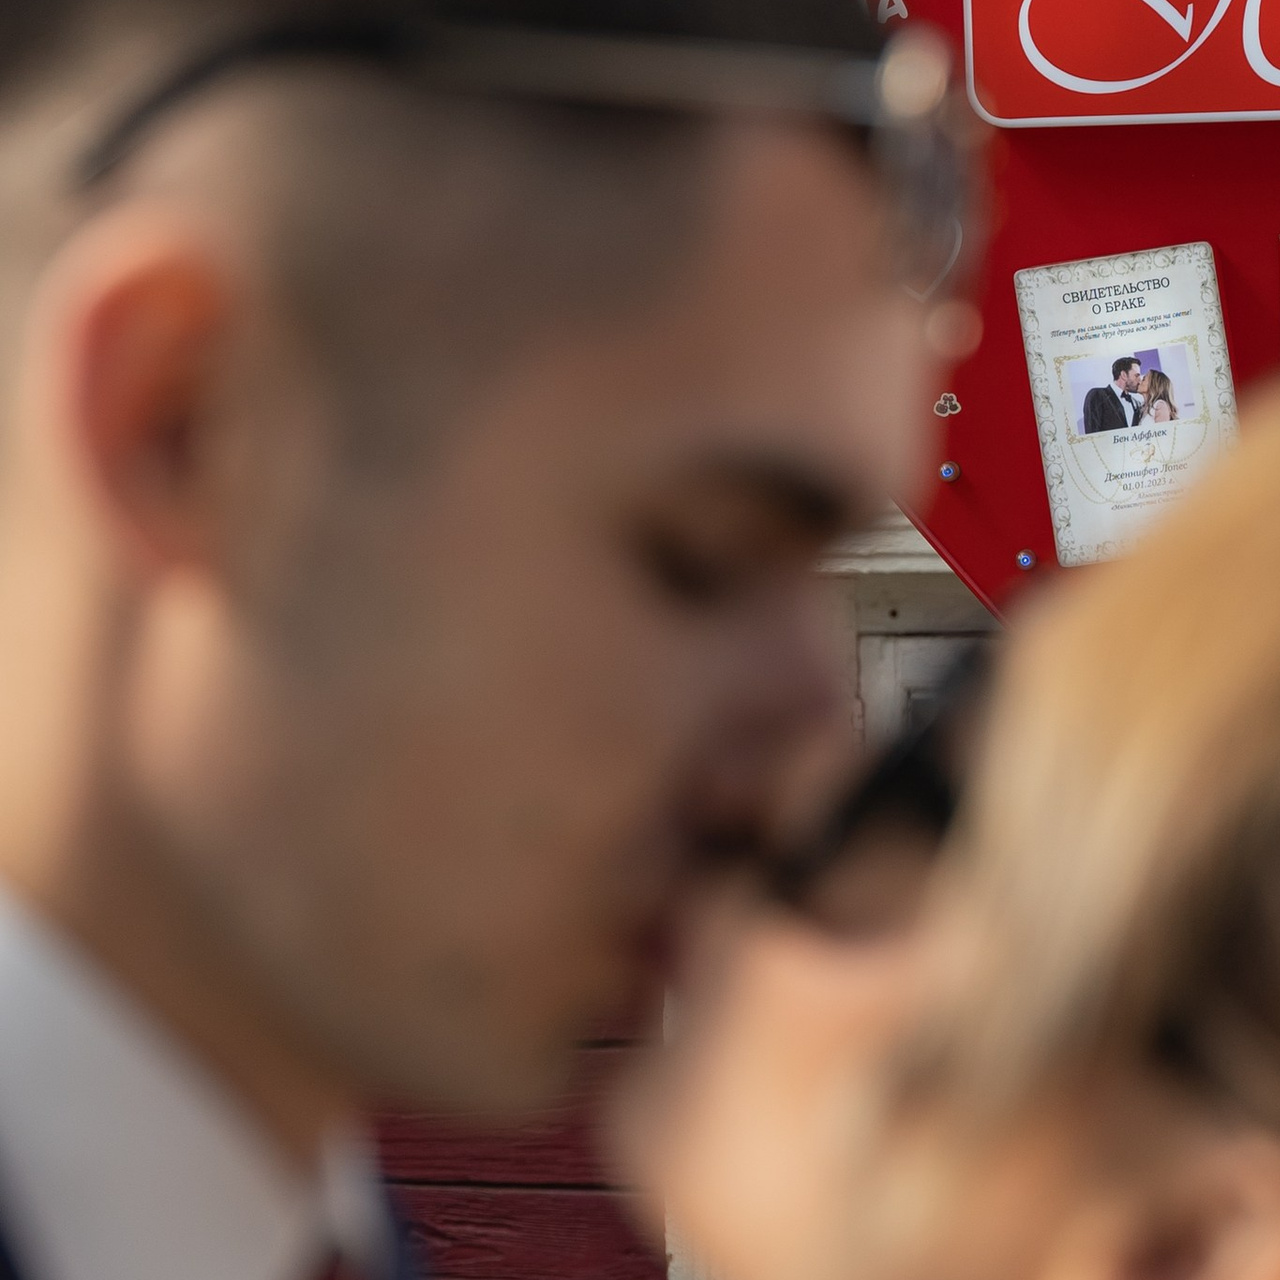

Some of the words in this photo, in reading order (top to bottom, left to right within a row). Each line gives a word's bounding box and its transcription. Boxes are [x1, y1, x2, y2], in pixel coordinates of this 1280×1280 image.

[1062, 277, 1170, 304] СВИДЕТЕЛЬСТВО
[1092, 303, 1102, 315] О
[1104, 296, 1146, 313] БРАКЕ
[1050, 328, 1076, 339] Теперь
[1113, 434, 1129, 444] Бен
[1130, 428, 1167, 442] Аффлек
[1104, 466, 1159, 483] Дженнифер
[1160, 462, 1188, 474] Лопес
[1122, 477, 1167, 491] 01.01.2023
